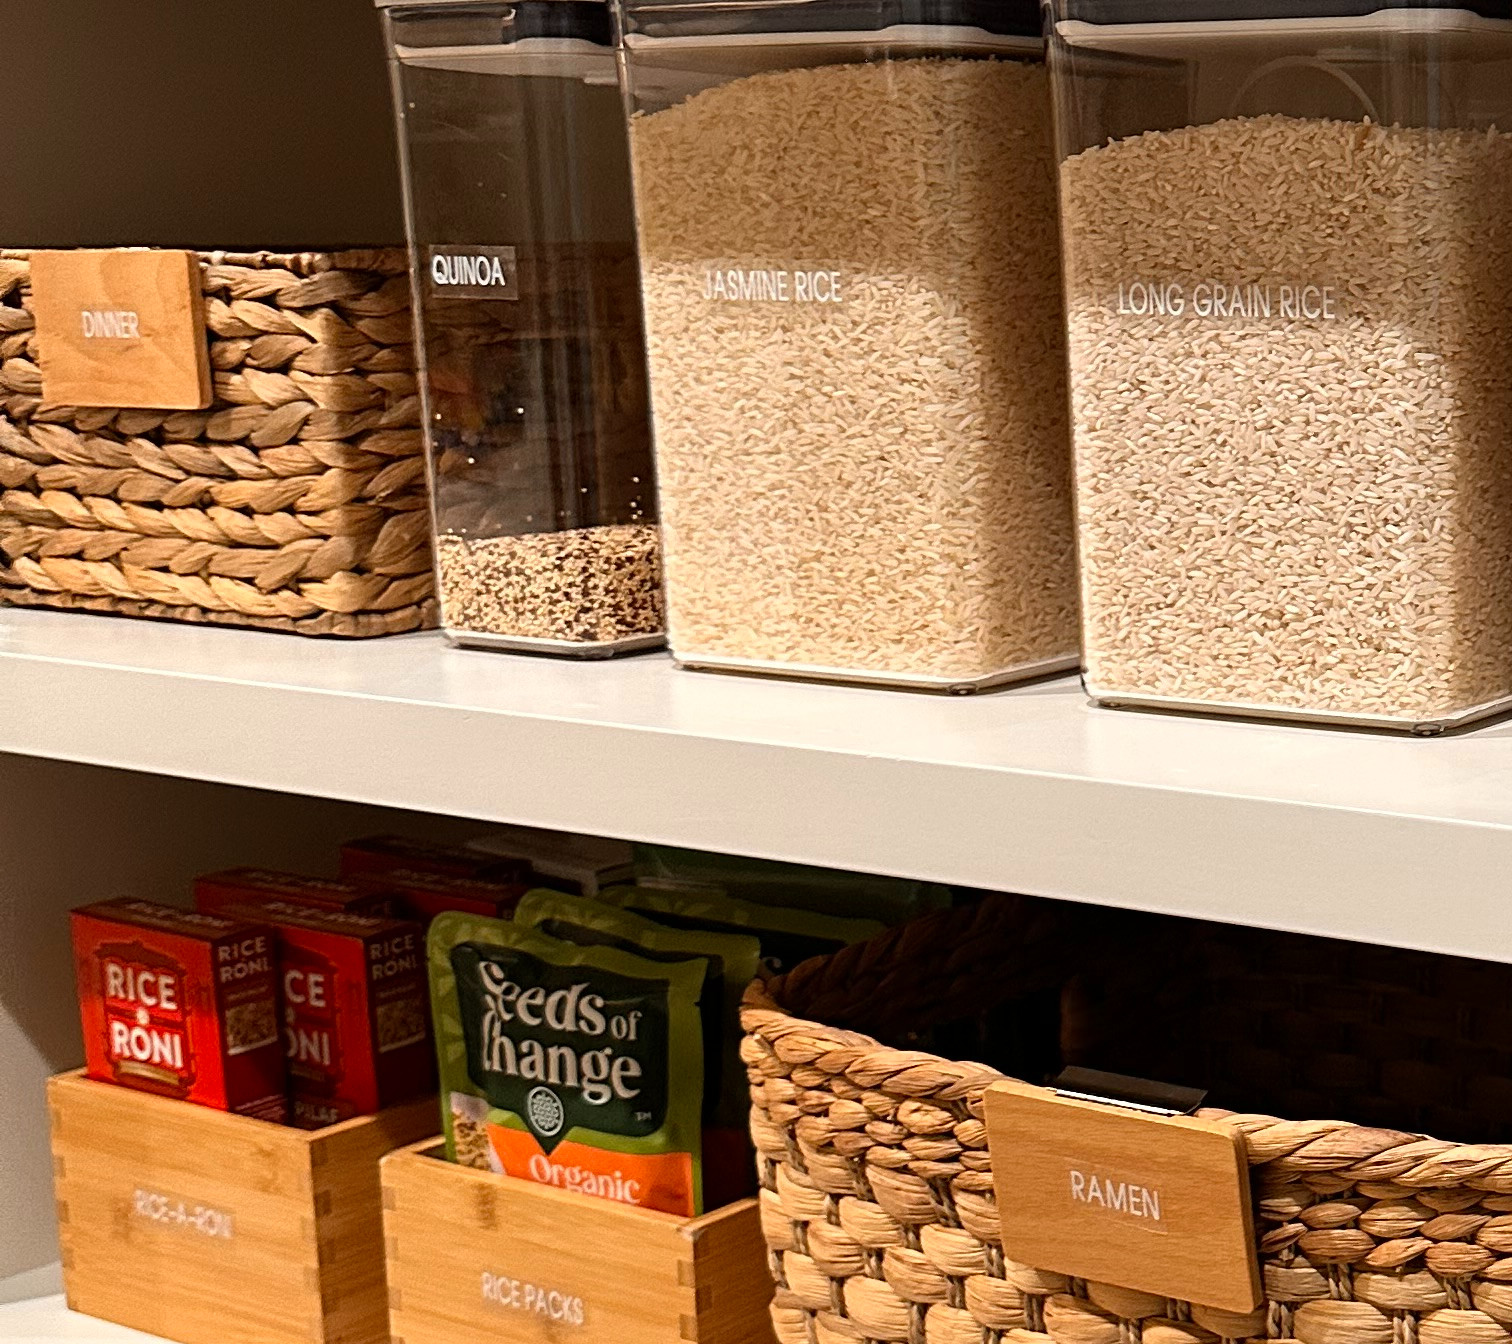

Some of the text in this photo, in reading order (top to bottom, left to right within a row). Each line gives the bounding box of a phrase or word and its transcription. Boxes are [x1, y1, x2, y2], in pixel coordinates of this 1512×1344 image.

[431, 254, 506, 287] QUINOA
[702, 270, 843, 304] JASMINE RICE
[1118, 282, 1336, 321] LONG GRAIN RICE
[81, 311, 141, 340] DINNER
[217, 936, 268, 963] RICE
[218, 957, 271, 984] RONI
[105, 961, 178, 1012] RICE
[284, 968, 327, 1008] CE
[477, 960, 643, 1042] Seeds of
[110, 1019, 185, 1069] RONI
[481, 1006, 643, 1105] Change
[528, 1153, 642, 1205] Organic
[1069, 1169, 1162, 1222] RAMEN
[481, 1271, 585, 1326] RICE PACKS
